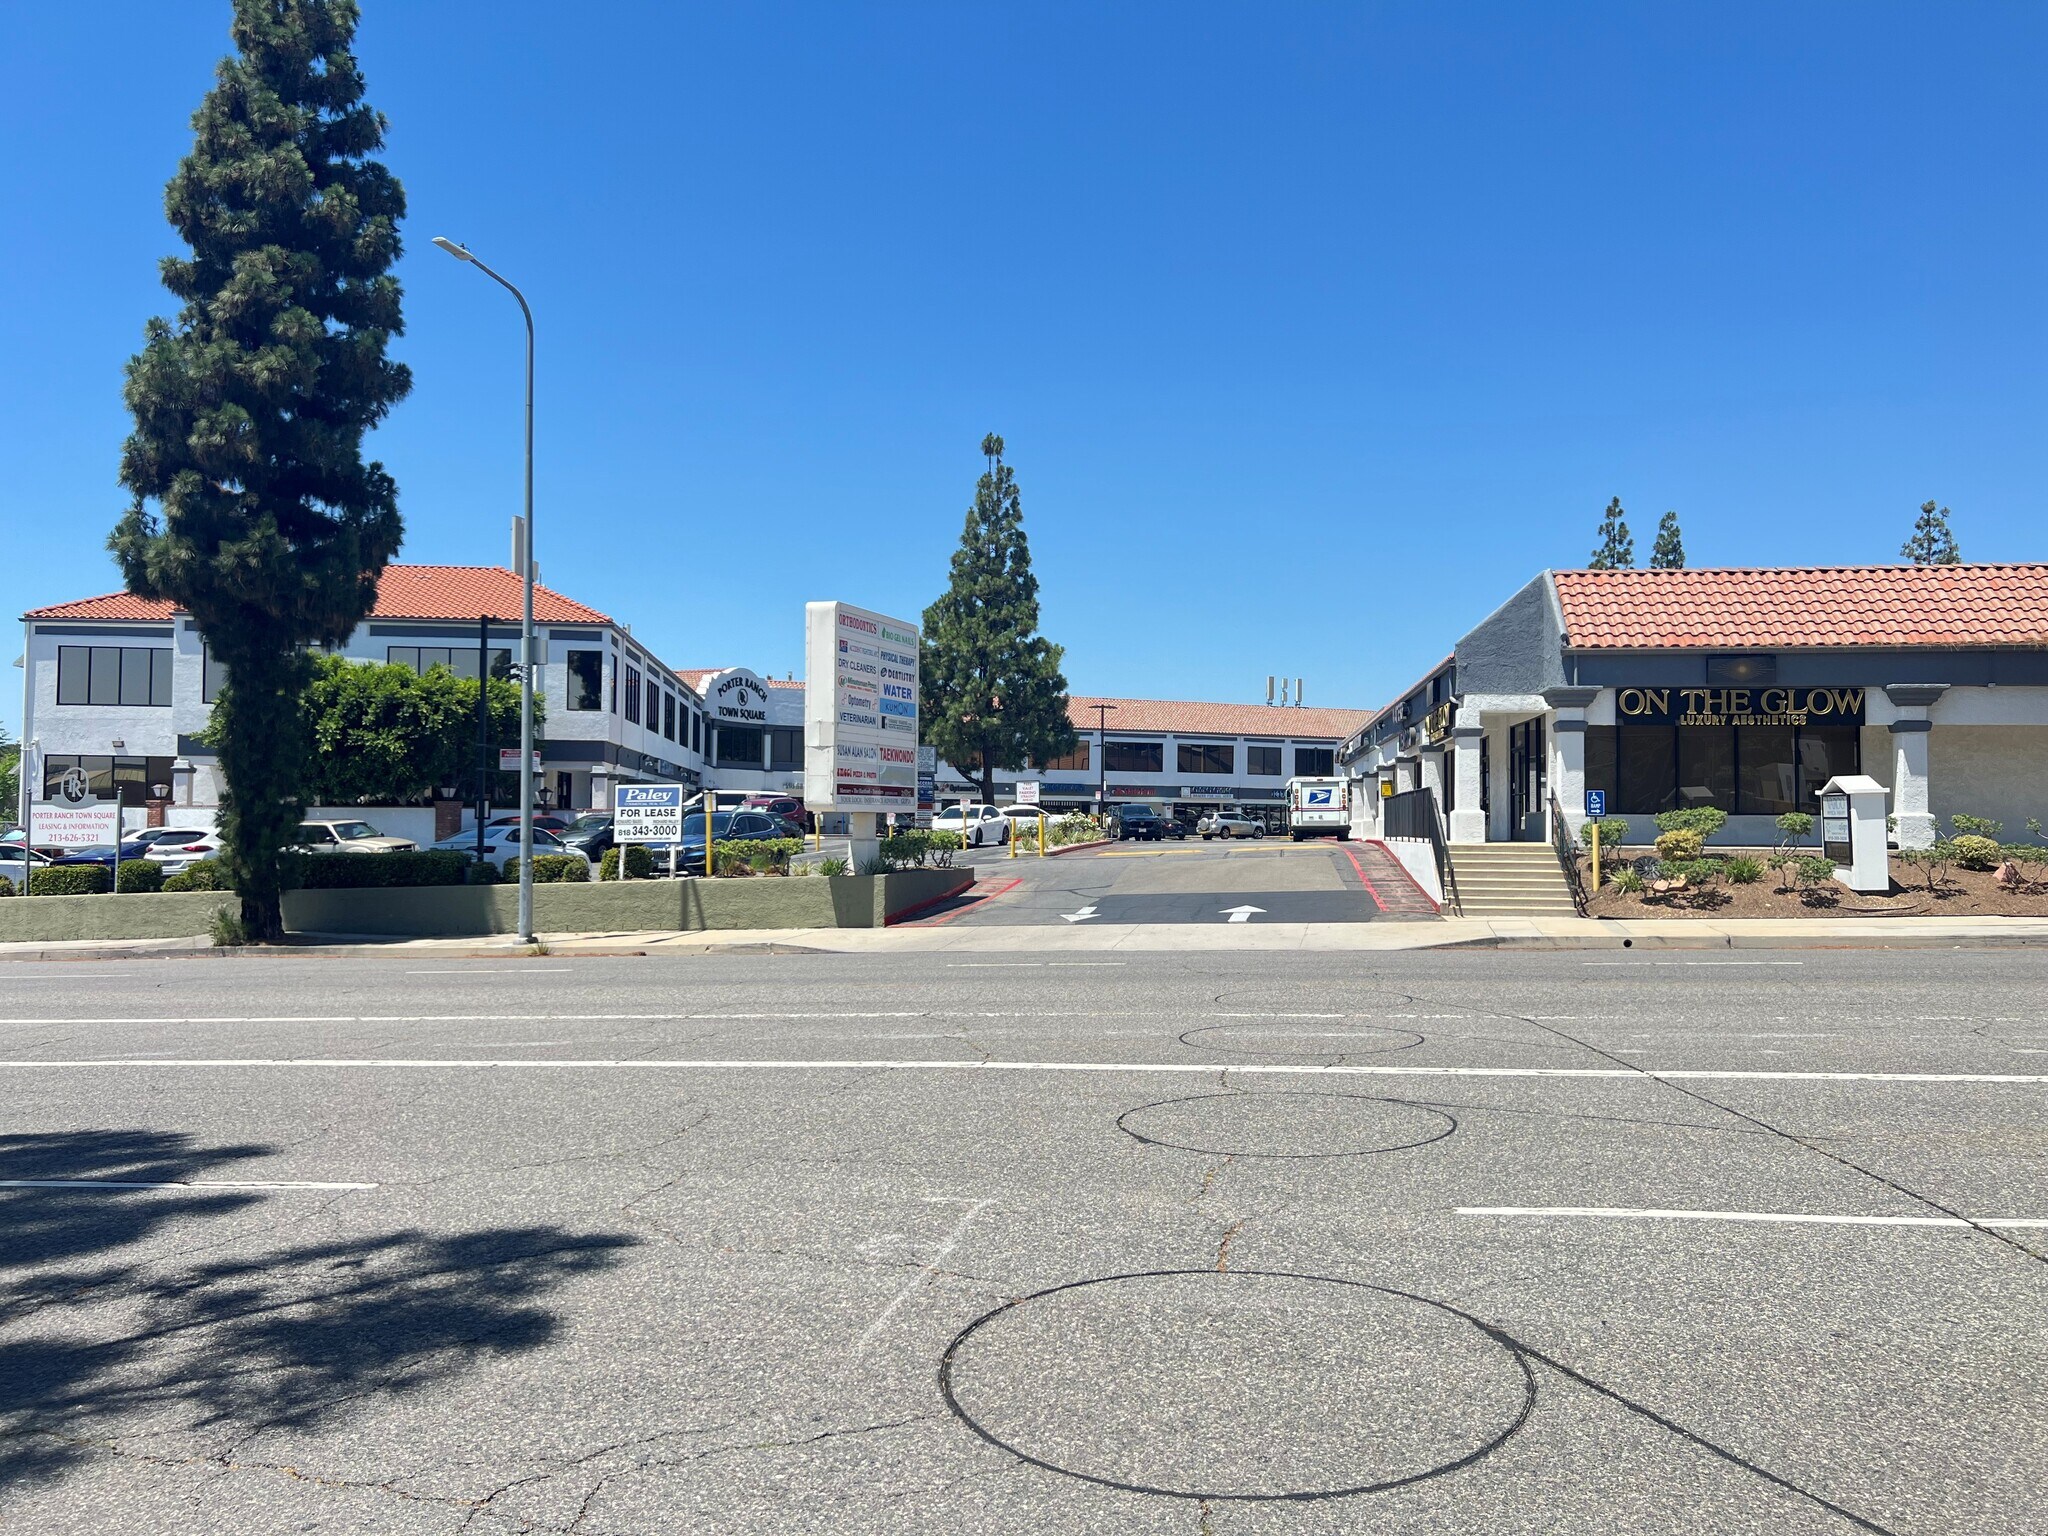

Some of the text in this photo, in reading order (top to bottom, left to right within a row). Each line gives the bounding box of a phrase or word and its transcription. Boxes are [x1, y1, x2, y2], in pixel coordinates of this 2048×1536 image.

[839, 613, 877, 635] ORTHODONTICS
[901, 635, 914, 646] NAILS
[881, 651, 898, 664] PHYSICAL
[899, 655, 915, 667] THERAPY
[838, 658, 877, 675] DRY CLEANERS
[888, 669, 915, 683] DENTISTRY
[718, 677, 743, 697] PORTER
[745, 678, 768, 702] RANCH
[883, 683, 912, 700] WATER
[848, 694, 871, 710] Optometry
[885, 703, 909, 715] KUMON
[1618, 688, 1866, 716] ON THE GLOW
[718, 706, 766, 720] TOWN SQUARE
[839, 712, 876, 725] VETERINARIAN
[1680, 714, 1807, 726] LUXURY AESTHETICS
[837, 744, 851, 757] SUSAN
[880, 748, 914, 764] TAEKWONDO
[626, 789, 672, 801] Paley
[620, 809, 676, 817] FOR LEASE
[632, 825, 677, 836] 343-3000
[48, 834, 99, 842] 213-626-5321
